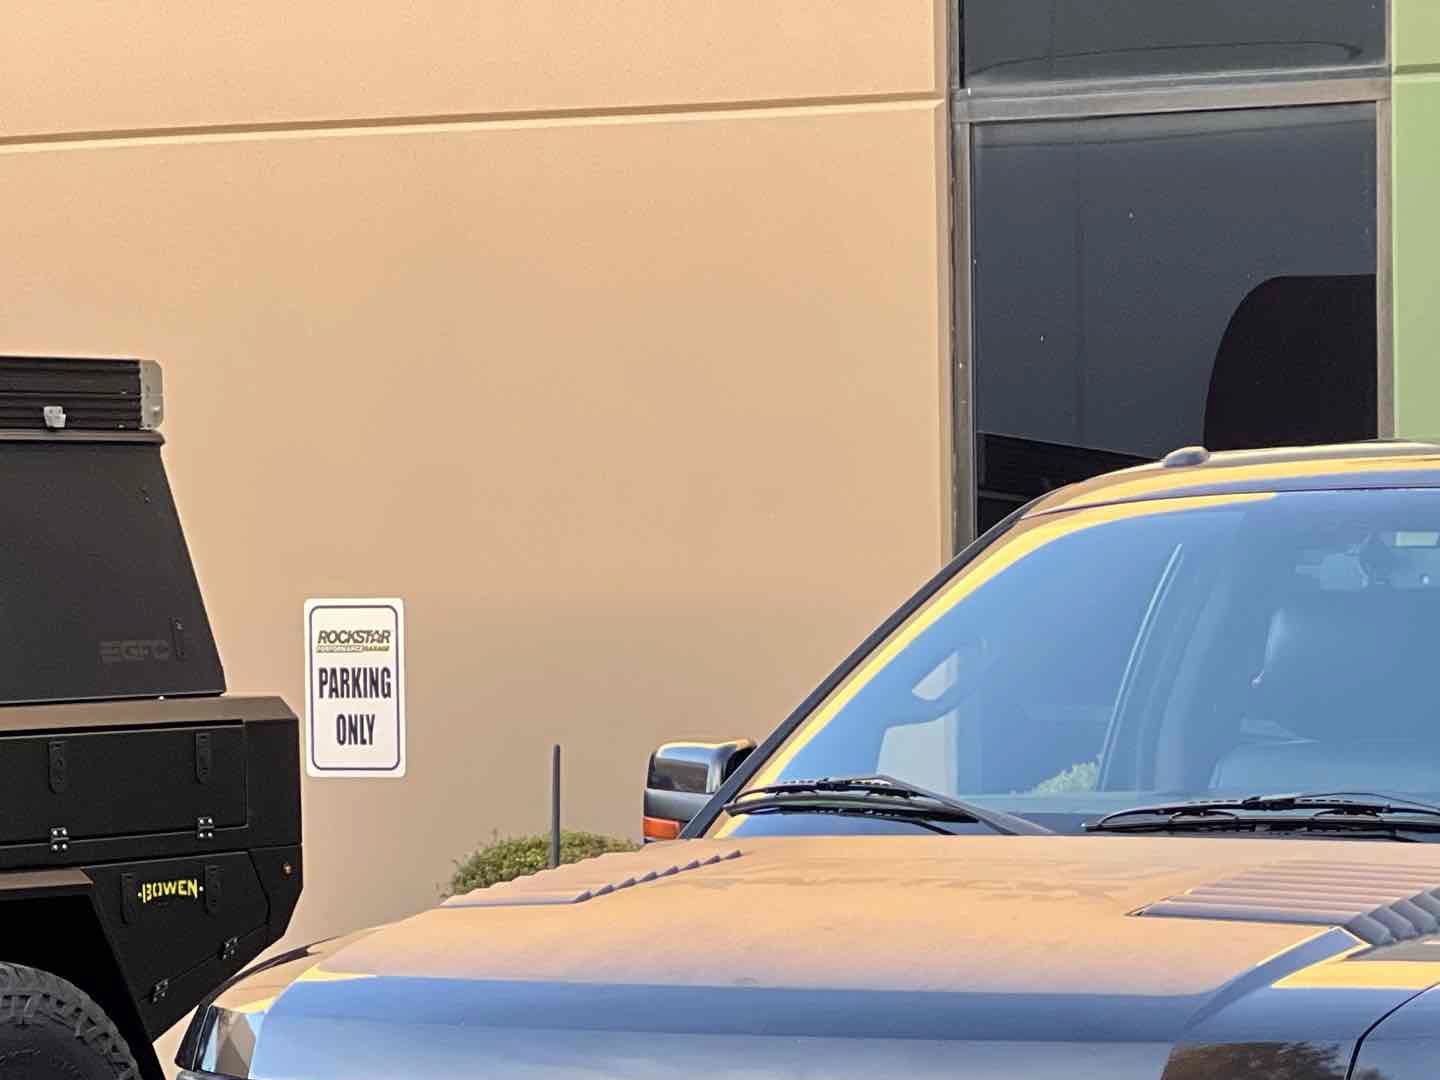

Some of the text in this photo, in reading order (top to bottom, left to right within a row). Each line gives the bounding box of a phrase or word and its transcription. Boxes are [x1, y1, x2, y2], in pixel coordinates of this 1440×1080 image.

[318, 666, 392, 699] PARKING
[336, 713, 376, 746] ONLY
[141, 878, 198, 904] BOWEN
